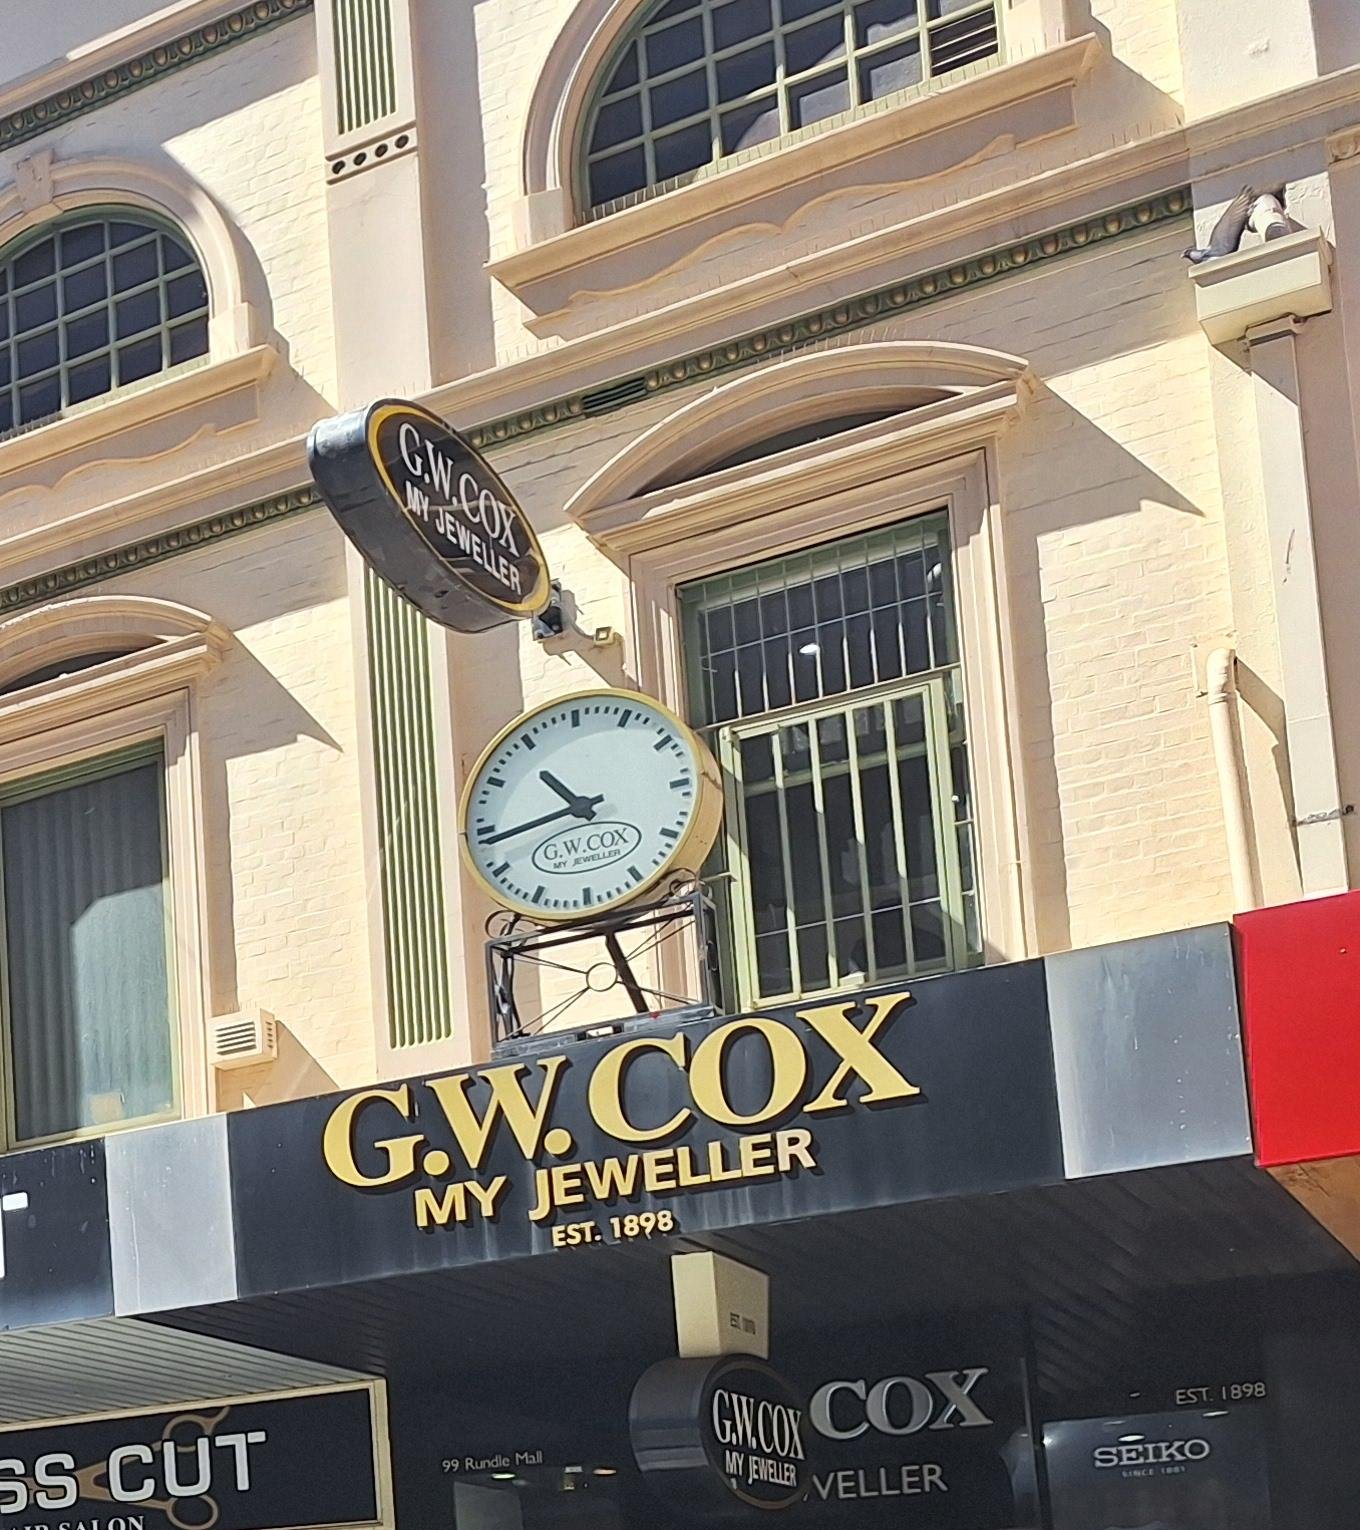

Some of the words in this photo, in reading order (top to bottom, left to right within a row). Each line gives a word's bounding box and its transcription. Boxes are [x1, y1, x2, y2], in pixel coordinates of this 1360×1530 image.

[406, 480, 429, 522] MY
[435, 507, 522, 596] JEWELLER
[553, 860, 568, 869] MY
[572, 849, 621, 867] JEWELLER
[415, 1175, 506, 1227] MY
[529, 1128, 817, 1222] JEWELLER
[552, 1222, 602, 1247] EST.
[610, 1210, 674, 1242] 1898
[809, 1367, 994, 1440] COX
[1175, 1387, 1214, 1405] EST.
[1222, 1382, 1267, 1400] 1898
[108, 1430, 267, 1502] CUT
[442, 1459, 459, 1472] 99
[465, 1454, 510, 1471] Rundle
[516, 1450, 543, 1466] Mall
[725, 1449, 744, 1477] MY
[748, 1455, 798, 1487] JEWELLER
[1093, 1439, 1211, 1468] SEIKO
